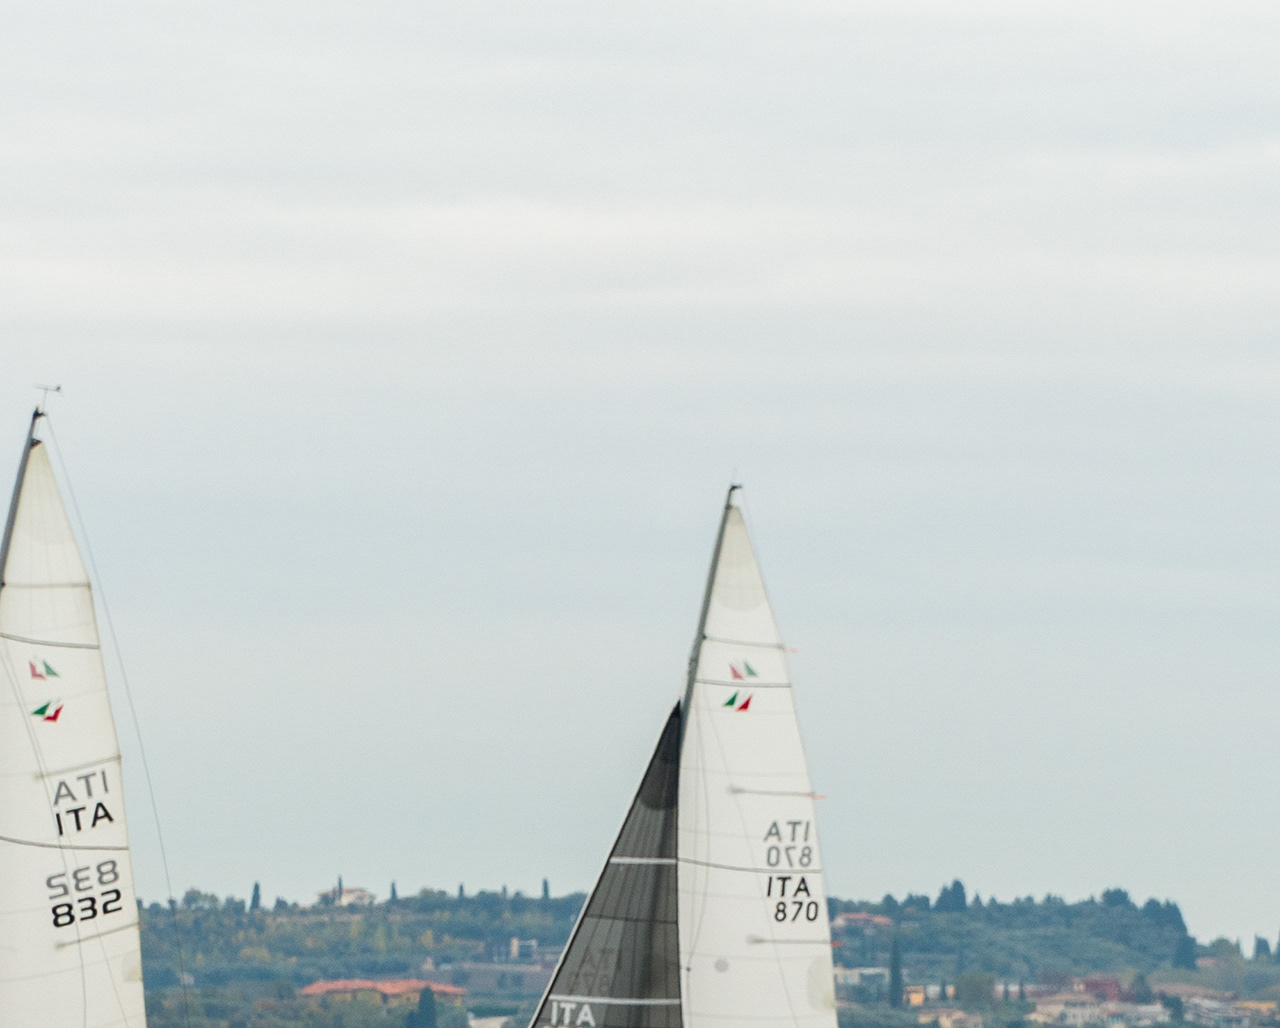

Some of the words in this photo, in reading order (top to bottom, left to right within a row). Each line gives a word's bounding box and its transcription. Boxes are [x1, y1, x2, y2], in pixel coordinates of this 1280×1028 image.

[55, 802, 114, 836] ITA
[766, 876, 811, 898] ITA
[51, 889, 123, 928] 832
[774, 901, 819, 923] 870
[550, 1001, 597, 1028] ITA
